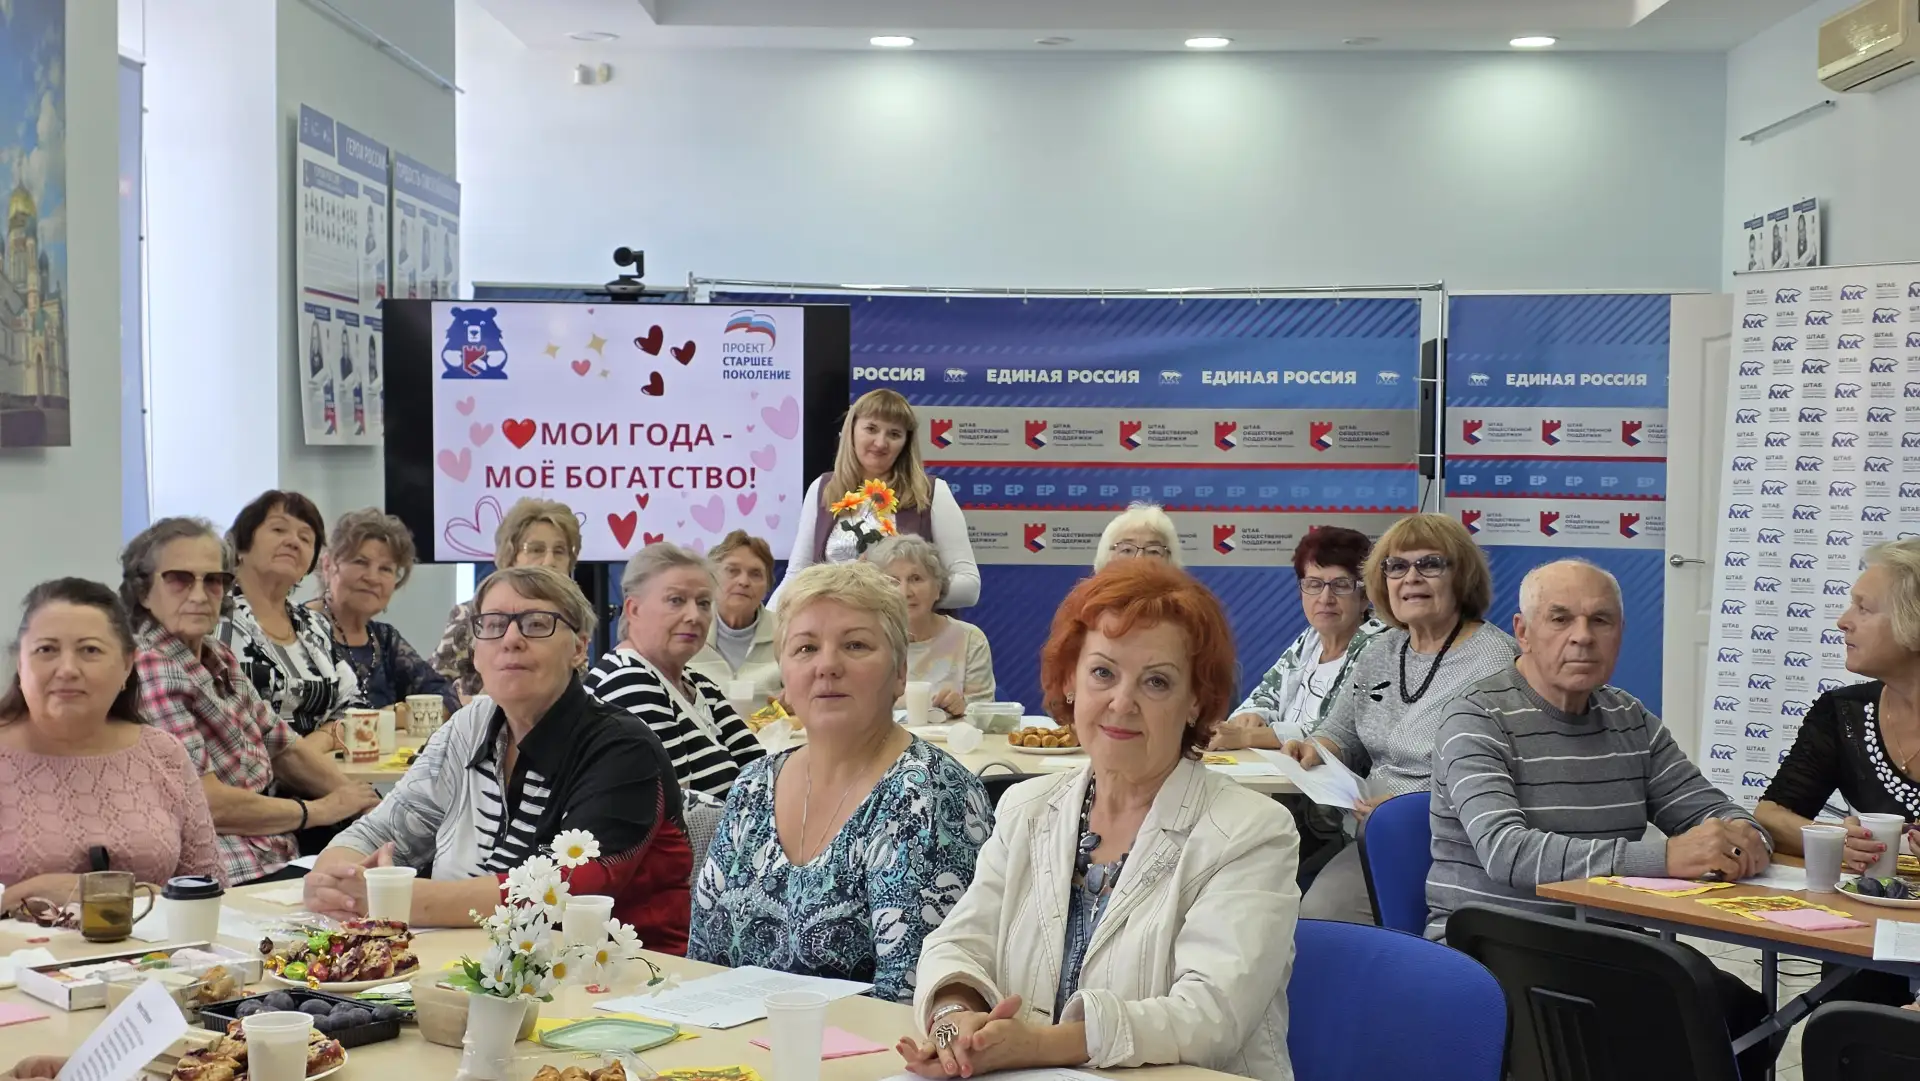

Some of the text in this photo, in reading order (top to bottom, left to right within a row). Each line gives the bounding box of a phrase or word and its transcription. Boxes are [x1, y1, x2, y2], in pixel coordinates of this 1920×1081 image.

[723, 343, 765, 353] ПРОЕКТ
[723, 357, 773, 366] СТАРШЕЕ
[723, 370, 790, 379] ПОКОЛЕНИЕ
[853, 367, 925, 381] РОССИЯ
[987, 369, 1139, 384] ЕДИНАЯ РОССИЯ
[1202, 371, 1356, 386] ЕДИНАЯ РОССИЯ
[1507, 374, 1647, 387] ЕДИНАЯ РОССИЯ
[542, 423, 617, 445] МОИ
[630, 424, 714, 452] ГОДА
[486, 460, 755, 489] МОЁ БОГАТСТВО!
[1459, 475, 1655, 487] ЕР ЕР ЕР ЕР ЕР ЕР
[951, 484, 961, 494] Р
[974, 484, 992, 495] ЕР
[1005, 485, 1024, 495] ЕР
[1037, 485, 1055, 496] ЕР
[1068, 485, 1087, 496] ЕР
[1100, 485, 1118, 496] ЕР
[1132, 485, 1150, 496] ЕР
[1163, 486, 1182, 497] ЕР
[1195, 486, 1214, 497] ЕР
[1227, 486, 1245, 497] ЕР
[1259, 486, 1278, 498] ЕР
[1291, 486, 1310, 498] ЕР
